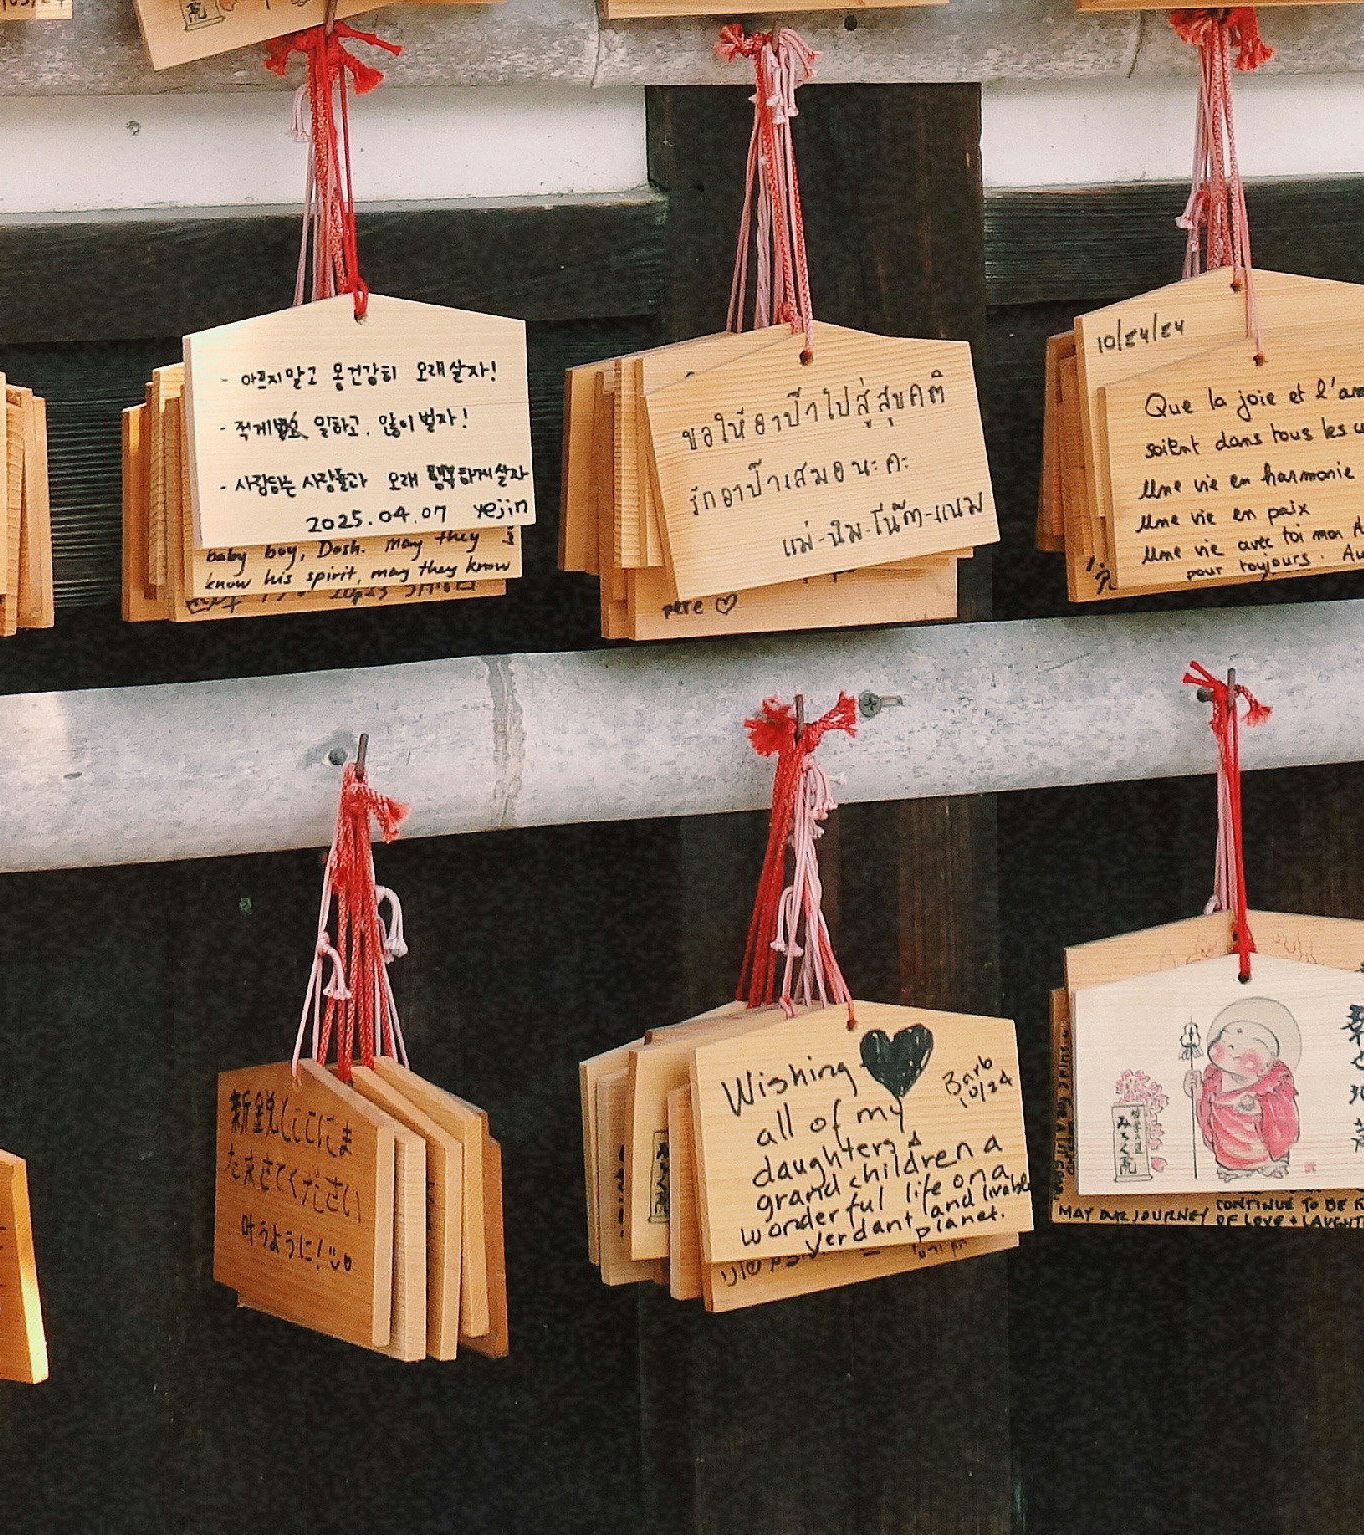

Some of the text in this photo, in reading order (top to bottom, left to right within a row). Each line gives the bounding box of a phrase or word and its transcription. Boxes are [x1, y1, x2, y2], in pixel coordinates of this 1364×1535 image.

[1144, 383, 1305, 423] Que la joie et
[1145, 416, 1348, 459] soient dans tous les
[1260, 461, 1355, 487] harmonie
[472, 498, 528, 520] yejin
[1266, 501, 1311, 520] paix
[465, 555, 511, 574] know
[720, 1055, 858, 1118] Wishing
[756, 1098, 906, 1147] all of my
[983, 1135, 1003, 1154] a
[906, 1172, 945, 1219] life
[930, 1187, 975, 1219] and
